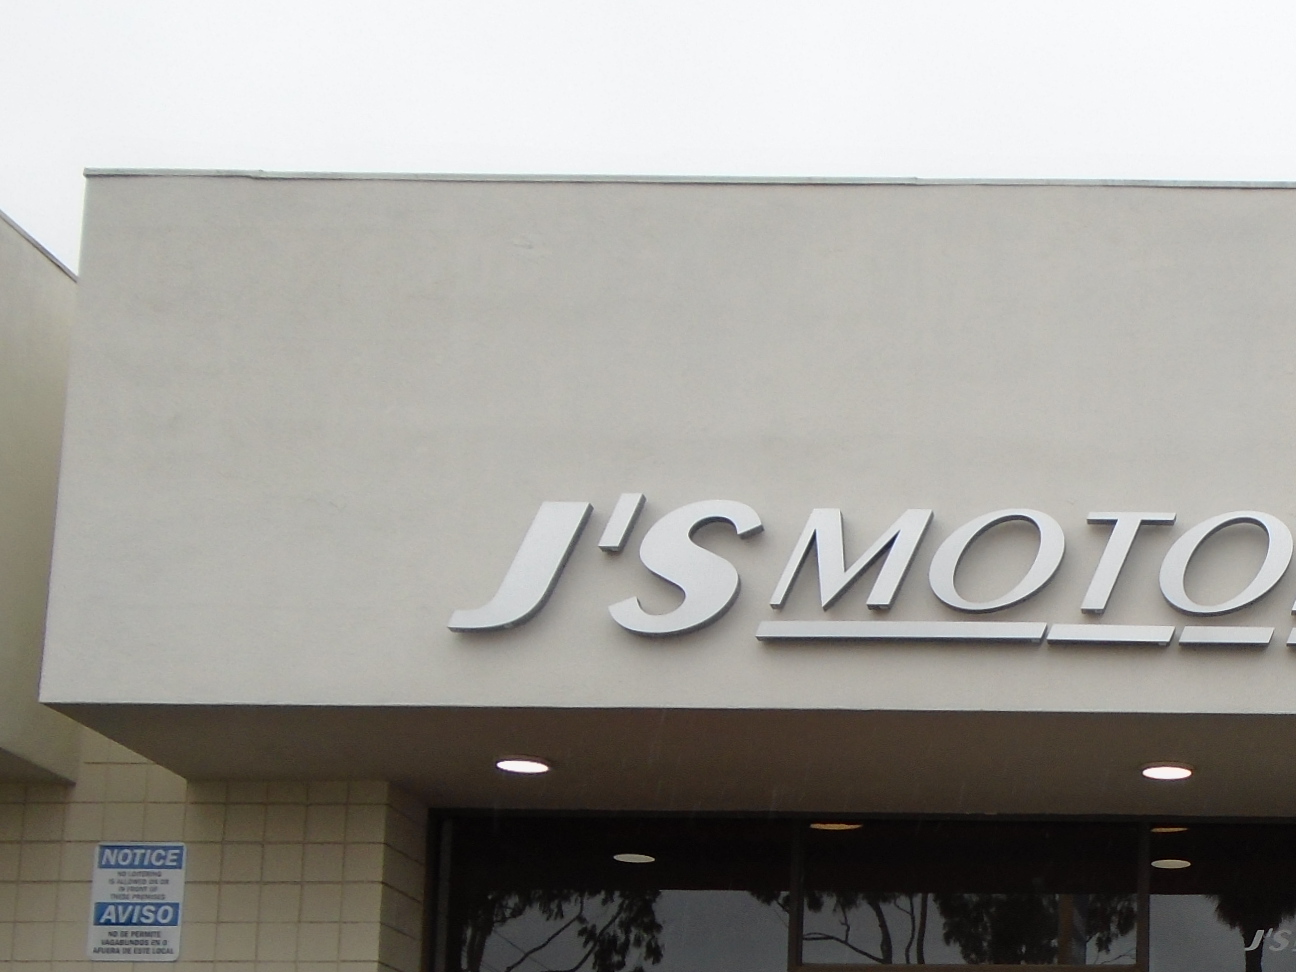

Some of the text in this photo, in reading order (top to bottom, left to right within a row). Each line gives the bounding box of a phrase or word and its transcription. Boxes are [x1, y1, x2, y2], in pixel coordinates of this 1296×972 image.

[447, 492, 765, 637] J'S
[101, 848, 180, 866] NOTICE
[99, 905, 173, 924] AVISO
[1243, 927, 1292, 951] J'S
